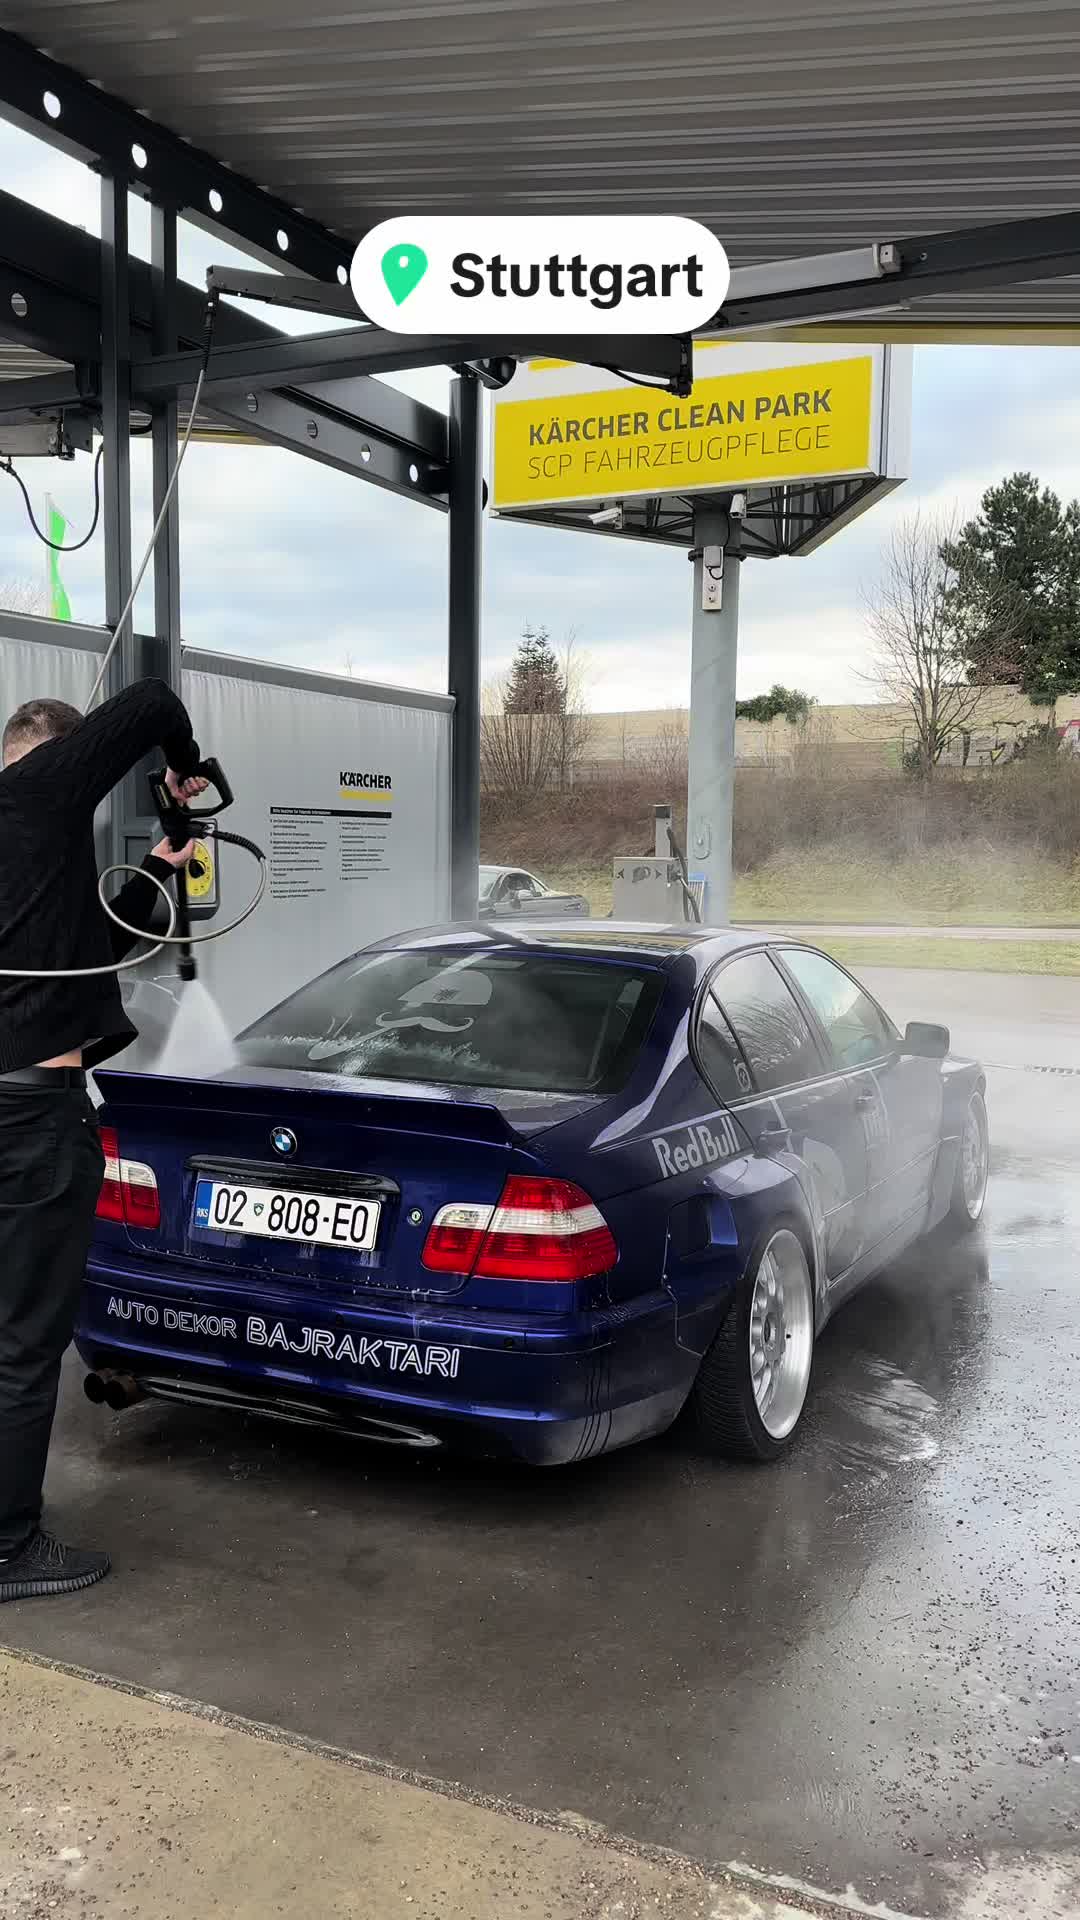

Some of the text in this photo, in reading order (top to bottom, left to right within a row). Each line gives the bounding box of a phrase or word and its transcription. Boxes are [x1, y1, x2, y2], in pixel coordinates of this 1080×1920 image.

[529, 388, 832, 446] KÄRCHER CLEAN PARK
[527, 424, 831, 479] SCP FAHRZEUGPFLEGE
[340, 771, 391, 789] KÄRCHER
[214, 1188, 248, 1227] 02
[107, 1296, 461, 1378] AUTO DEKOR BAJRAKTARI
